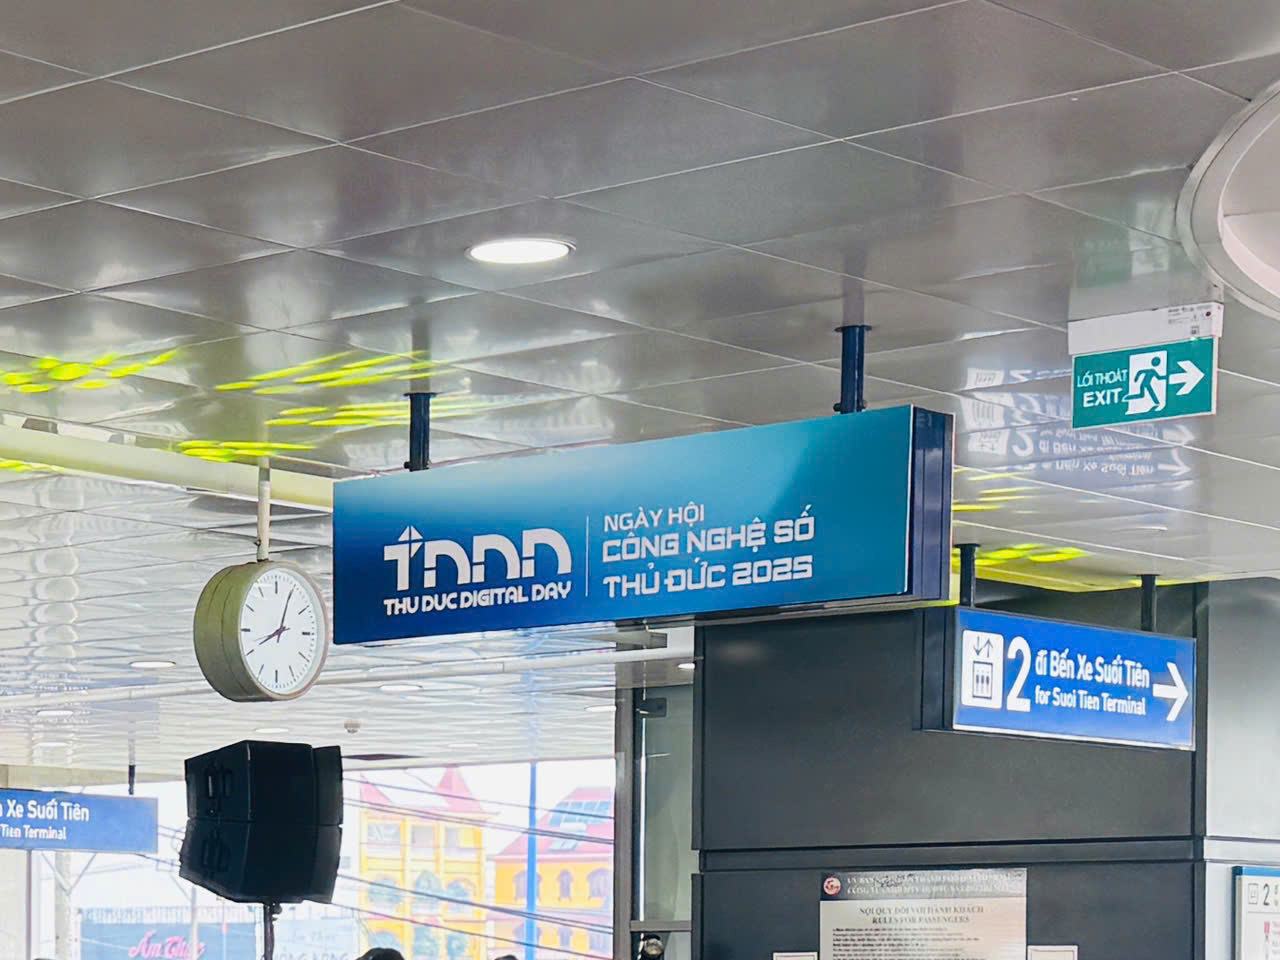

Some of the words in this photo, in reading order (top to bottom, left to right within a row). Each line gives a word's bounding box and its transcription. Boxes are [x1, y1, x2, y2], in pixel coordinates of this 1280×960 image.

[1083, 388, 1122, 407] EXIT
[602, 531, 680, 562] CÔNG
[687, 516, 766, 553] NGHỆ
[774, 504, 815, 544] SỐ
[604, 506, 663, 532] NGÀY
[668, 501, 705, 527] HỘI
[602, 562, 660, 598] THỦ
[664, 557, 726, 593] ĐỨC
[732, 555, 813, 586] 2025
[383, 596, 420, 616] THU
[422, 592, 458, 612] DUC
[460, 586, 528, 608] DIGITAL
[532, 581, 572, 602] DAY
[1006, 636, 1032, 712] 2
[1035, 649, 1048, 676] đi
[1050, 648, 1075, 680] Bến
[1077, 653, 1094, 681] Xe
[1094, 654, 1122, 684] Suối
[1124, 660, 1150, 688] Tiên
[1035, 684, 1051, 704] for
[1052, 686, 1076, 708] Suoi
[1078, 689, 1100, 711] Tien
[1101, 692, 1146, 716] Terminal
[6, 799, 24, 818] Xe
[27, 798, 58, 820] Suối
[60, 801, 90, 822] Tiên
[23, 824, 67, 840] Terminal
